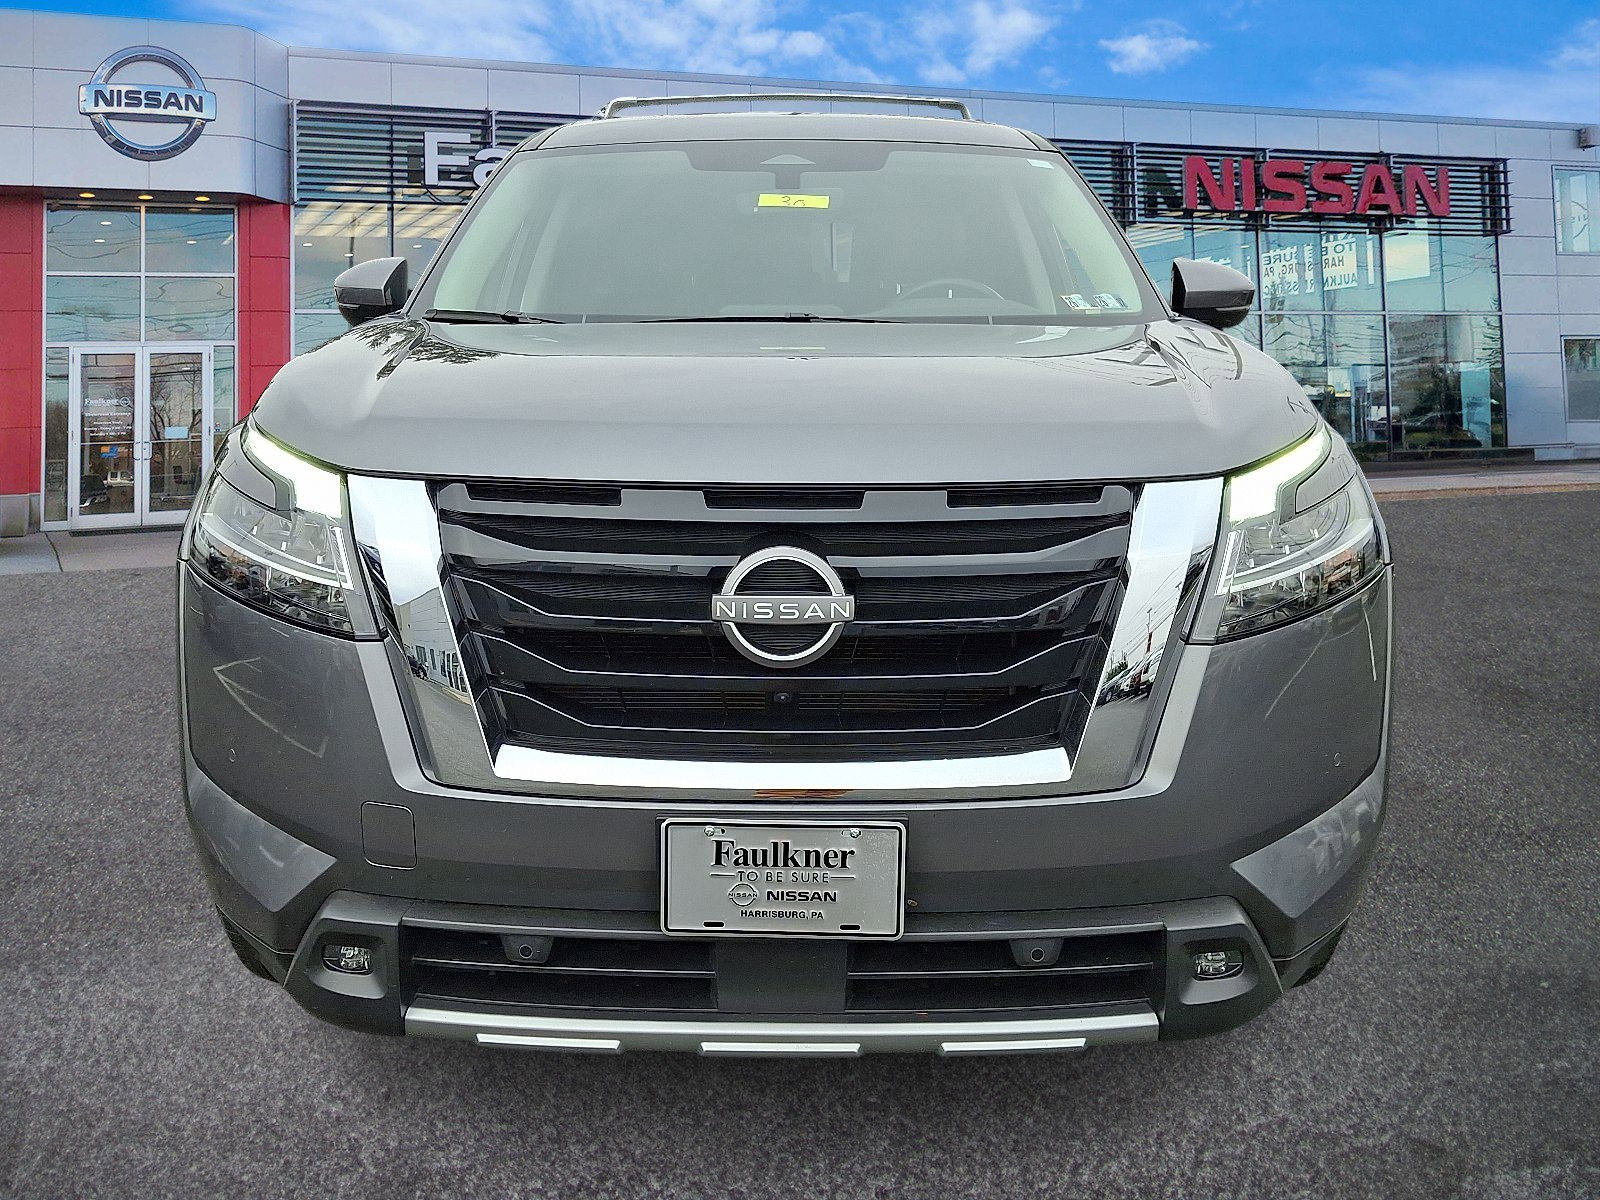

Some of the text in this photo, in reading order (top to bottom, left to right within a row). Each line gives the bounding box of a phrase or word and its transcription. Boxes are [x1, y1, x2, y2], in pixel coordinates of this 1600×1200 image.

[94, 89, 203, 113] NISSAN
[1183, 155, 1450, 217] NISSAN
[716, 601, 850, 619] NISSAN
[710, 839, 856, 868] Faulkner
[737, 871, 829, 883] TO BE SURE
[766, 890, 837, 903] NISSAN
[740, 909, 824, 920] HARRISBURG, PA
